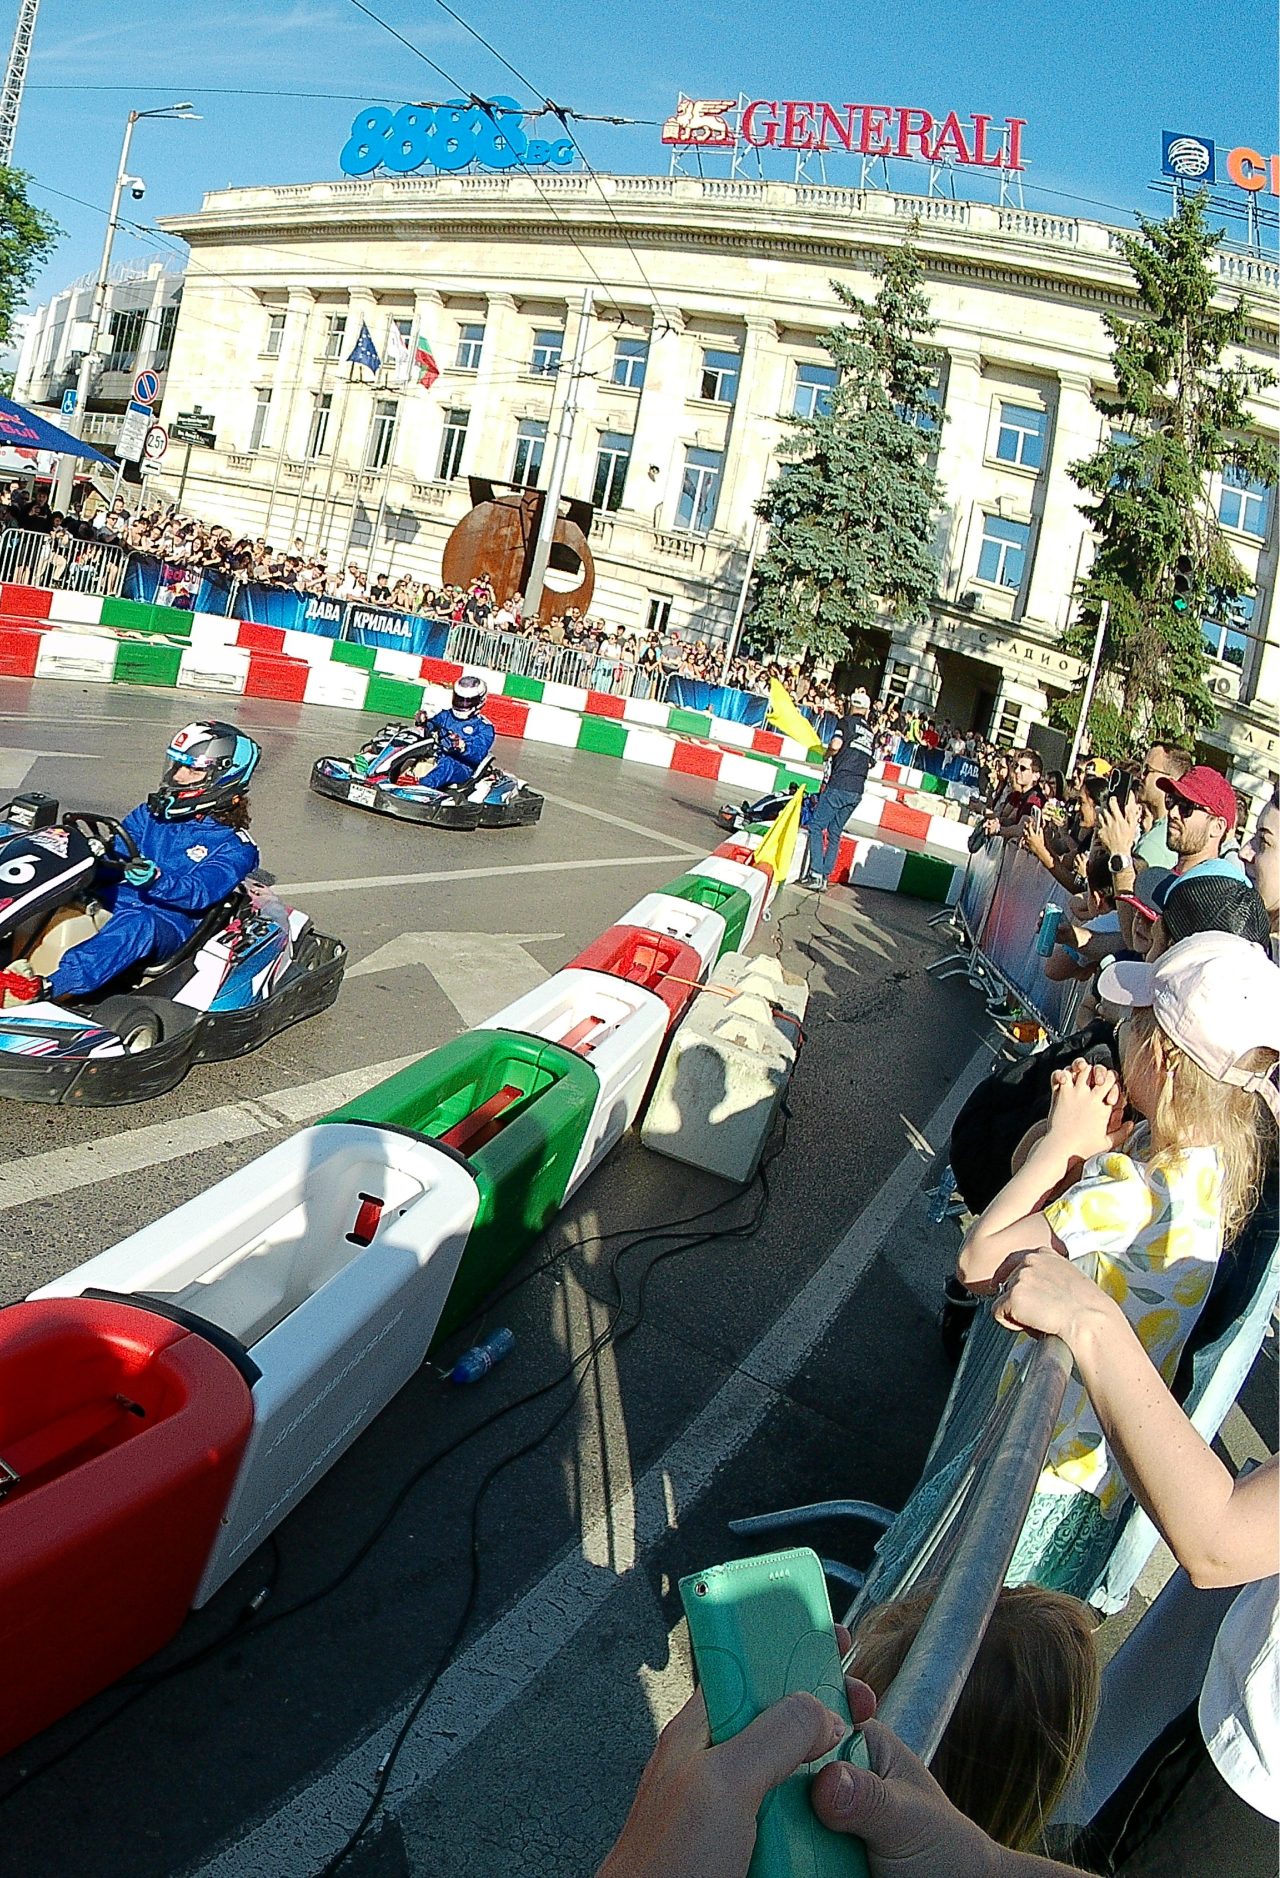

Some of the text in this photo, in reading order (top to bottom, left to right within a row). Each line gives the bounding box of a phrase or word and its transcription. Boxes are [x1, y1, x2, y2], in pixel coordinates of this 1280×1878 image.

[742, 99, 1028, 171] GENERALI
[305, 598, 341, 622] ДАВА
[353, 610, 413, 637] КРИЛААА.
